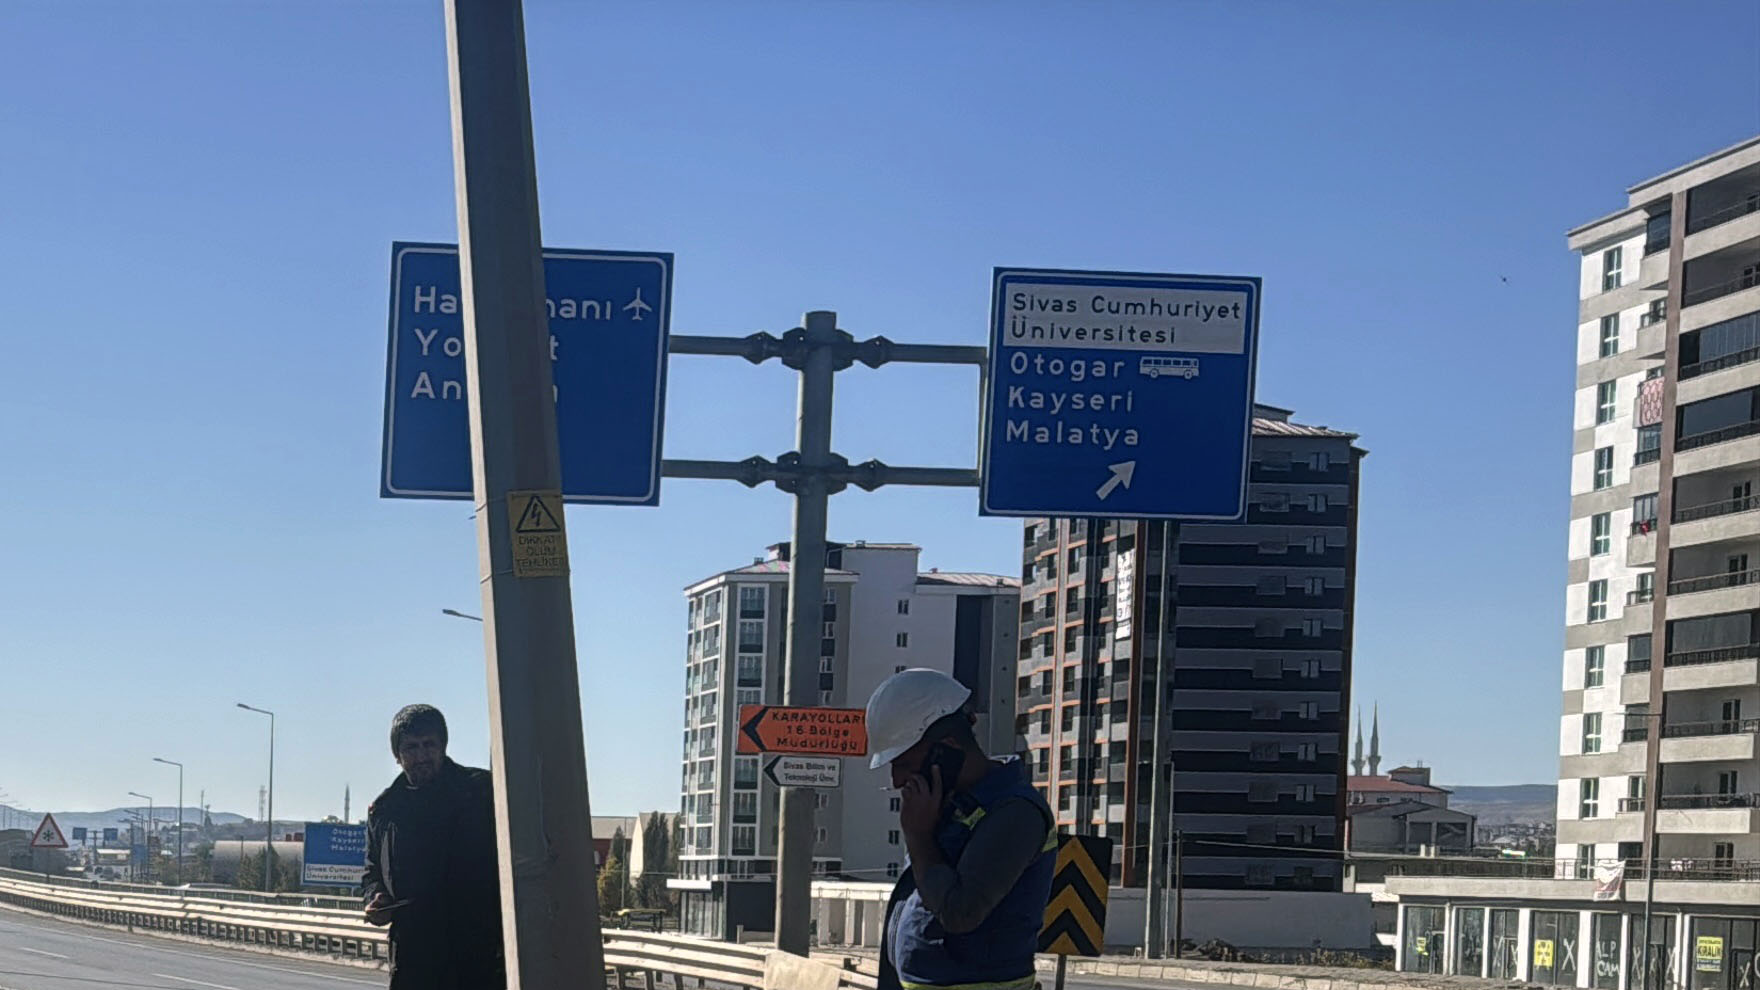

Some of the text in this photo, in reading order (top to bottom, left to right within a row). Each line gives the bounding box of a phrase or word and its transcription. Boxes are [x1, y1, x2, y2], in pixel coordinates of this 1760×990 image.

[1012, 293, 1240, 322] Sivas Cumhuriyet
[1011, 315, 1175, 344] Üniversitesi
[1010, 352, 1125, 381] Otogar
[1008, 386, 1133, 415] Kayseri
[1006, 420, 1138, 450] Malatya
